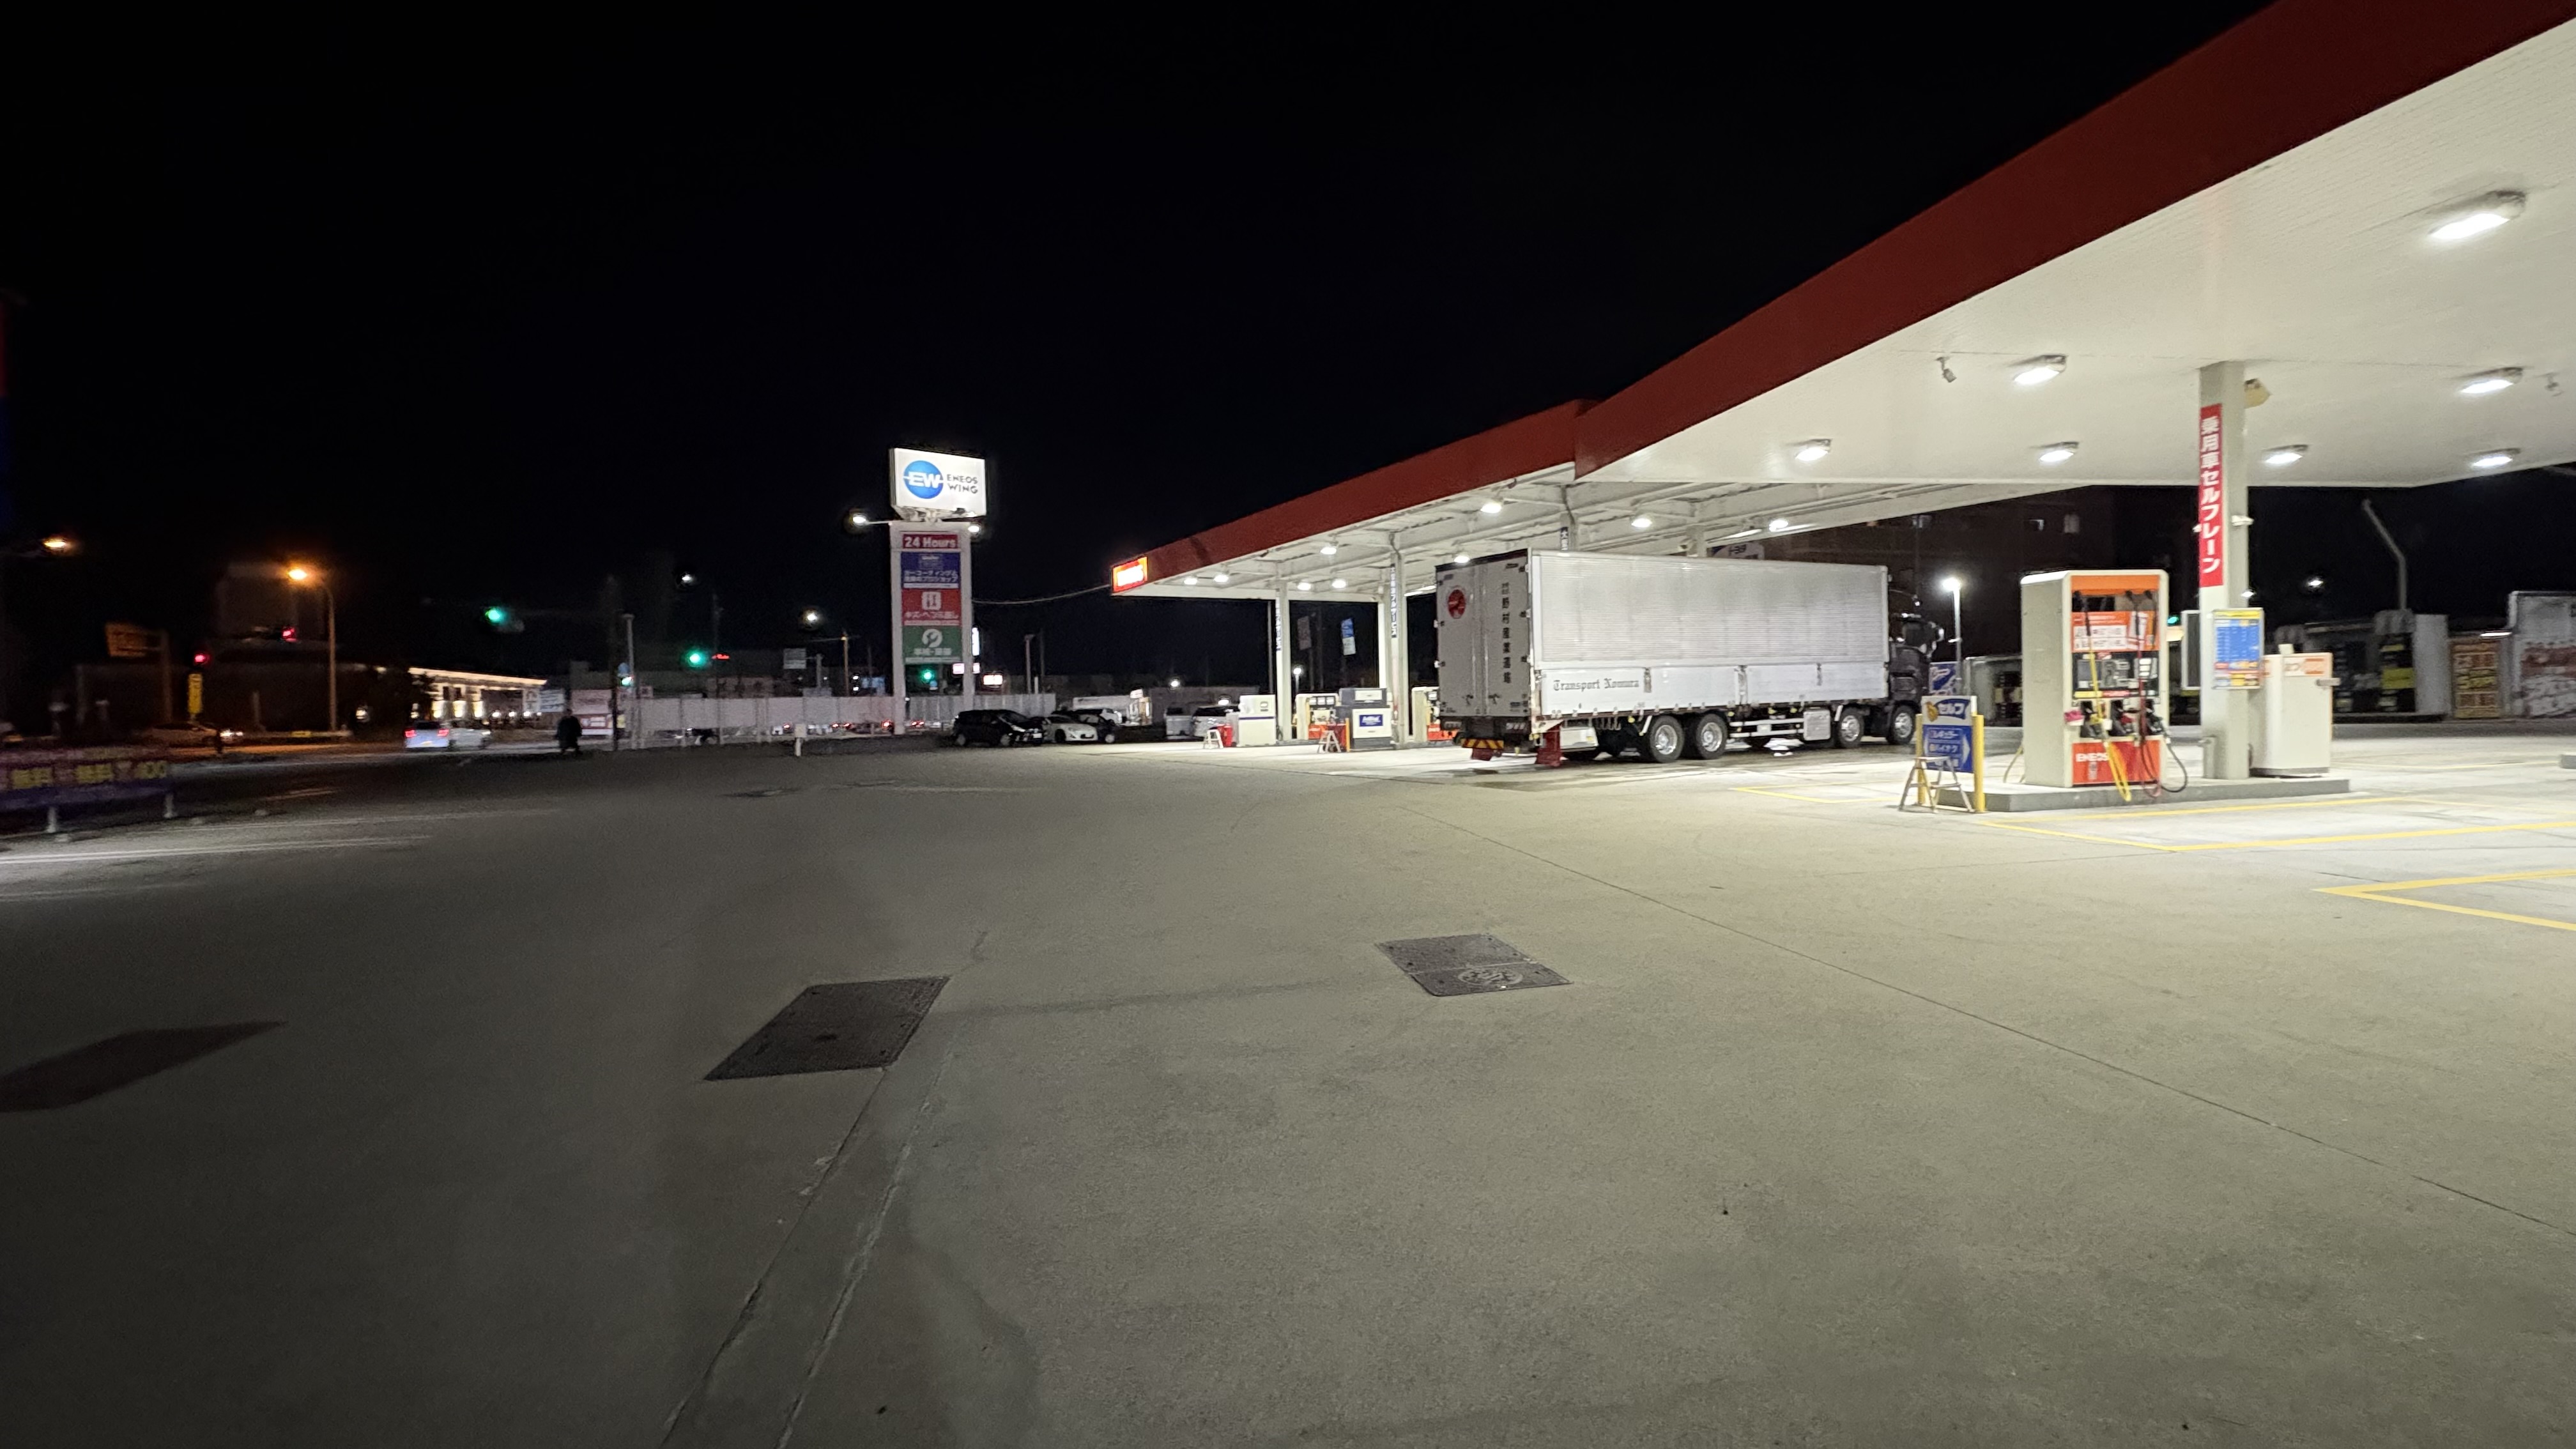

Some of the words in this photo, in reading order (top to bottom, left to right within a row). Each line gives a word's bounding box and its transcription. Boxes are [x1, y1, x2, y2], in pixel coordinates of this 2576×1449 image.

[908, 471, 942, 489] EW
[947, 474, 978, 484] ENEOS
[947, 483, 978, 494] WING
[2200, 416, 2220, 574] 乗用車セルフレーン
[904, 536, 920, 548] 24
[923, 537, 956, 548] Hours
[1553, 679, 1600, 692] Transport
[1937, 703, 1965, 716] セルフ
